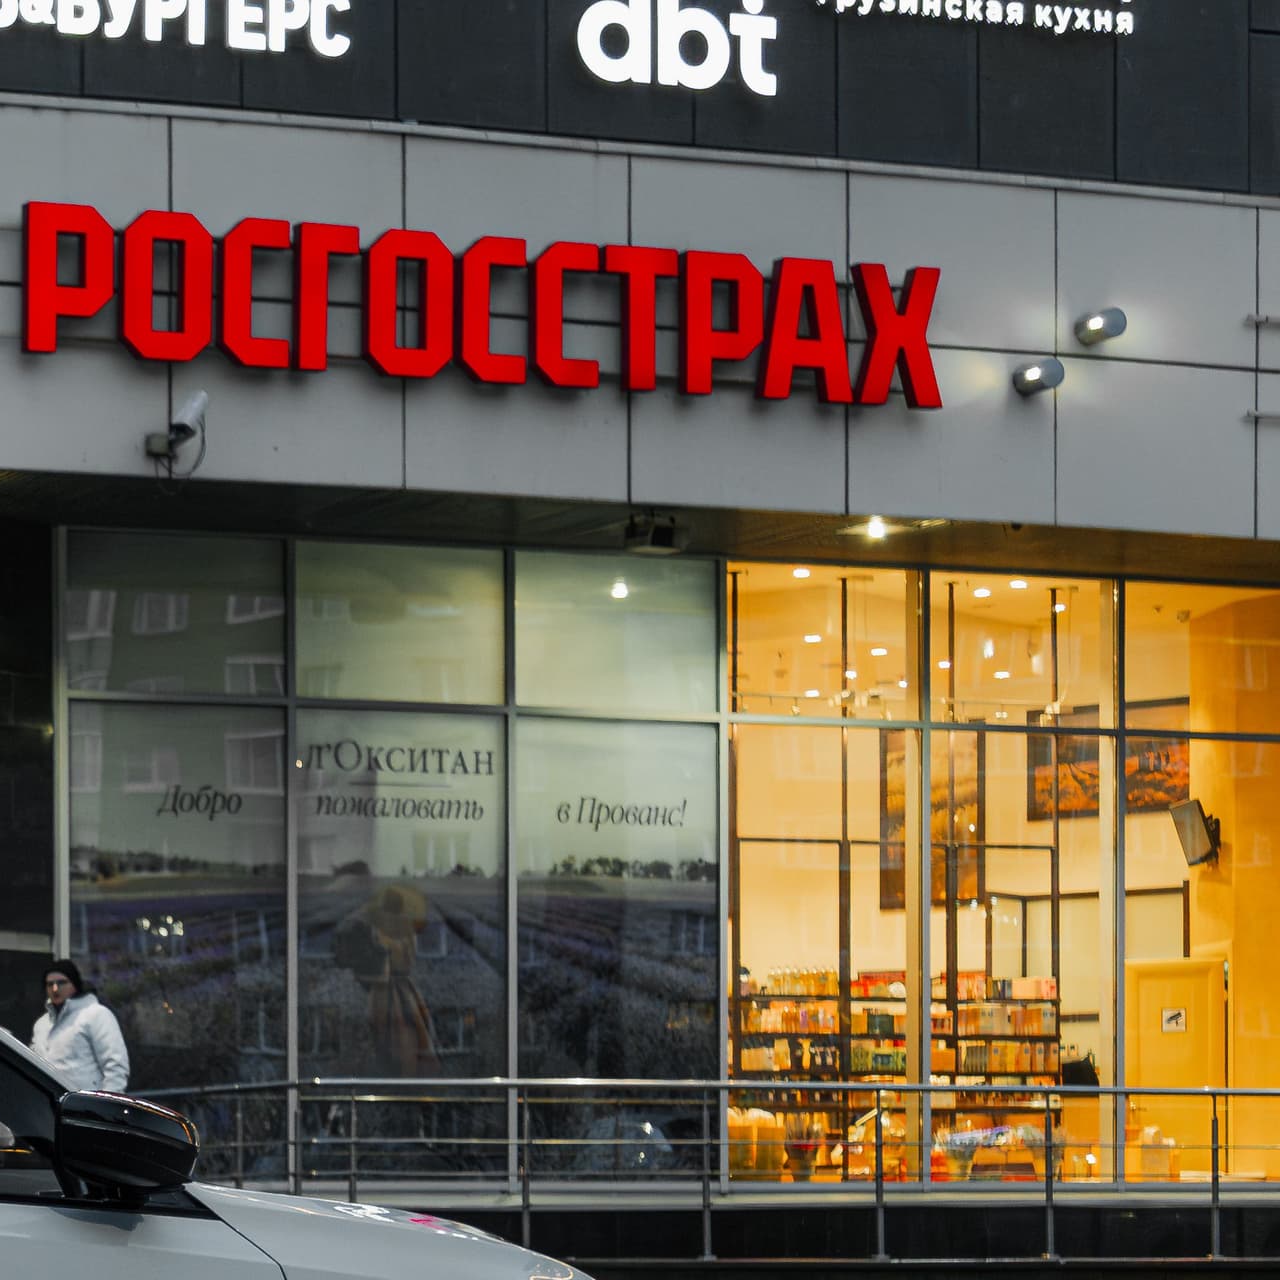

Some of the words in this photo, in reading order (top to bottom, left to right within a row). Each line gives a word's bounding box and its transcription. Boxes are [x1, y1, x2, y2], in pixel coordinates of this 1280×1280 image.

[1034, 3, 1135, 36] кухня
[21, 201, 942, 408] РОСГОССТРАХ
[156, 784, 243, 821] Добро
[316, 795, 484, 821] пожаловать
[557, 803, 571, 824] в
[577, 796, 687, 832] Прованс!
